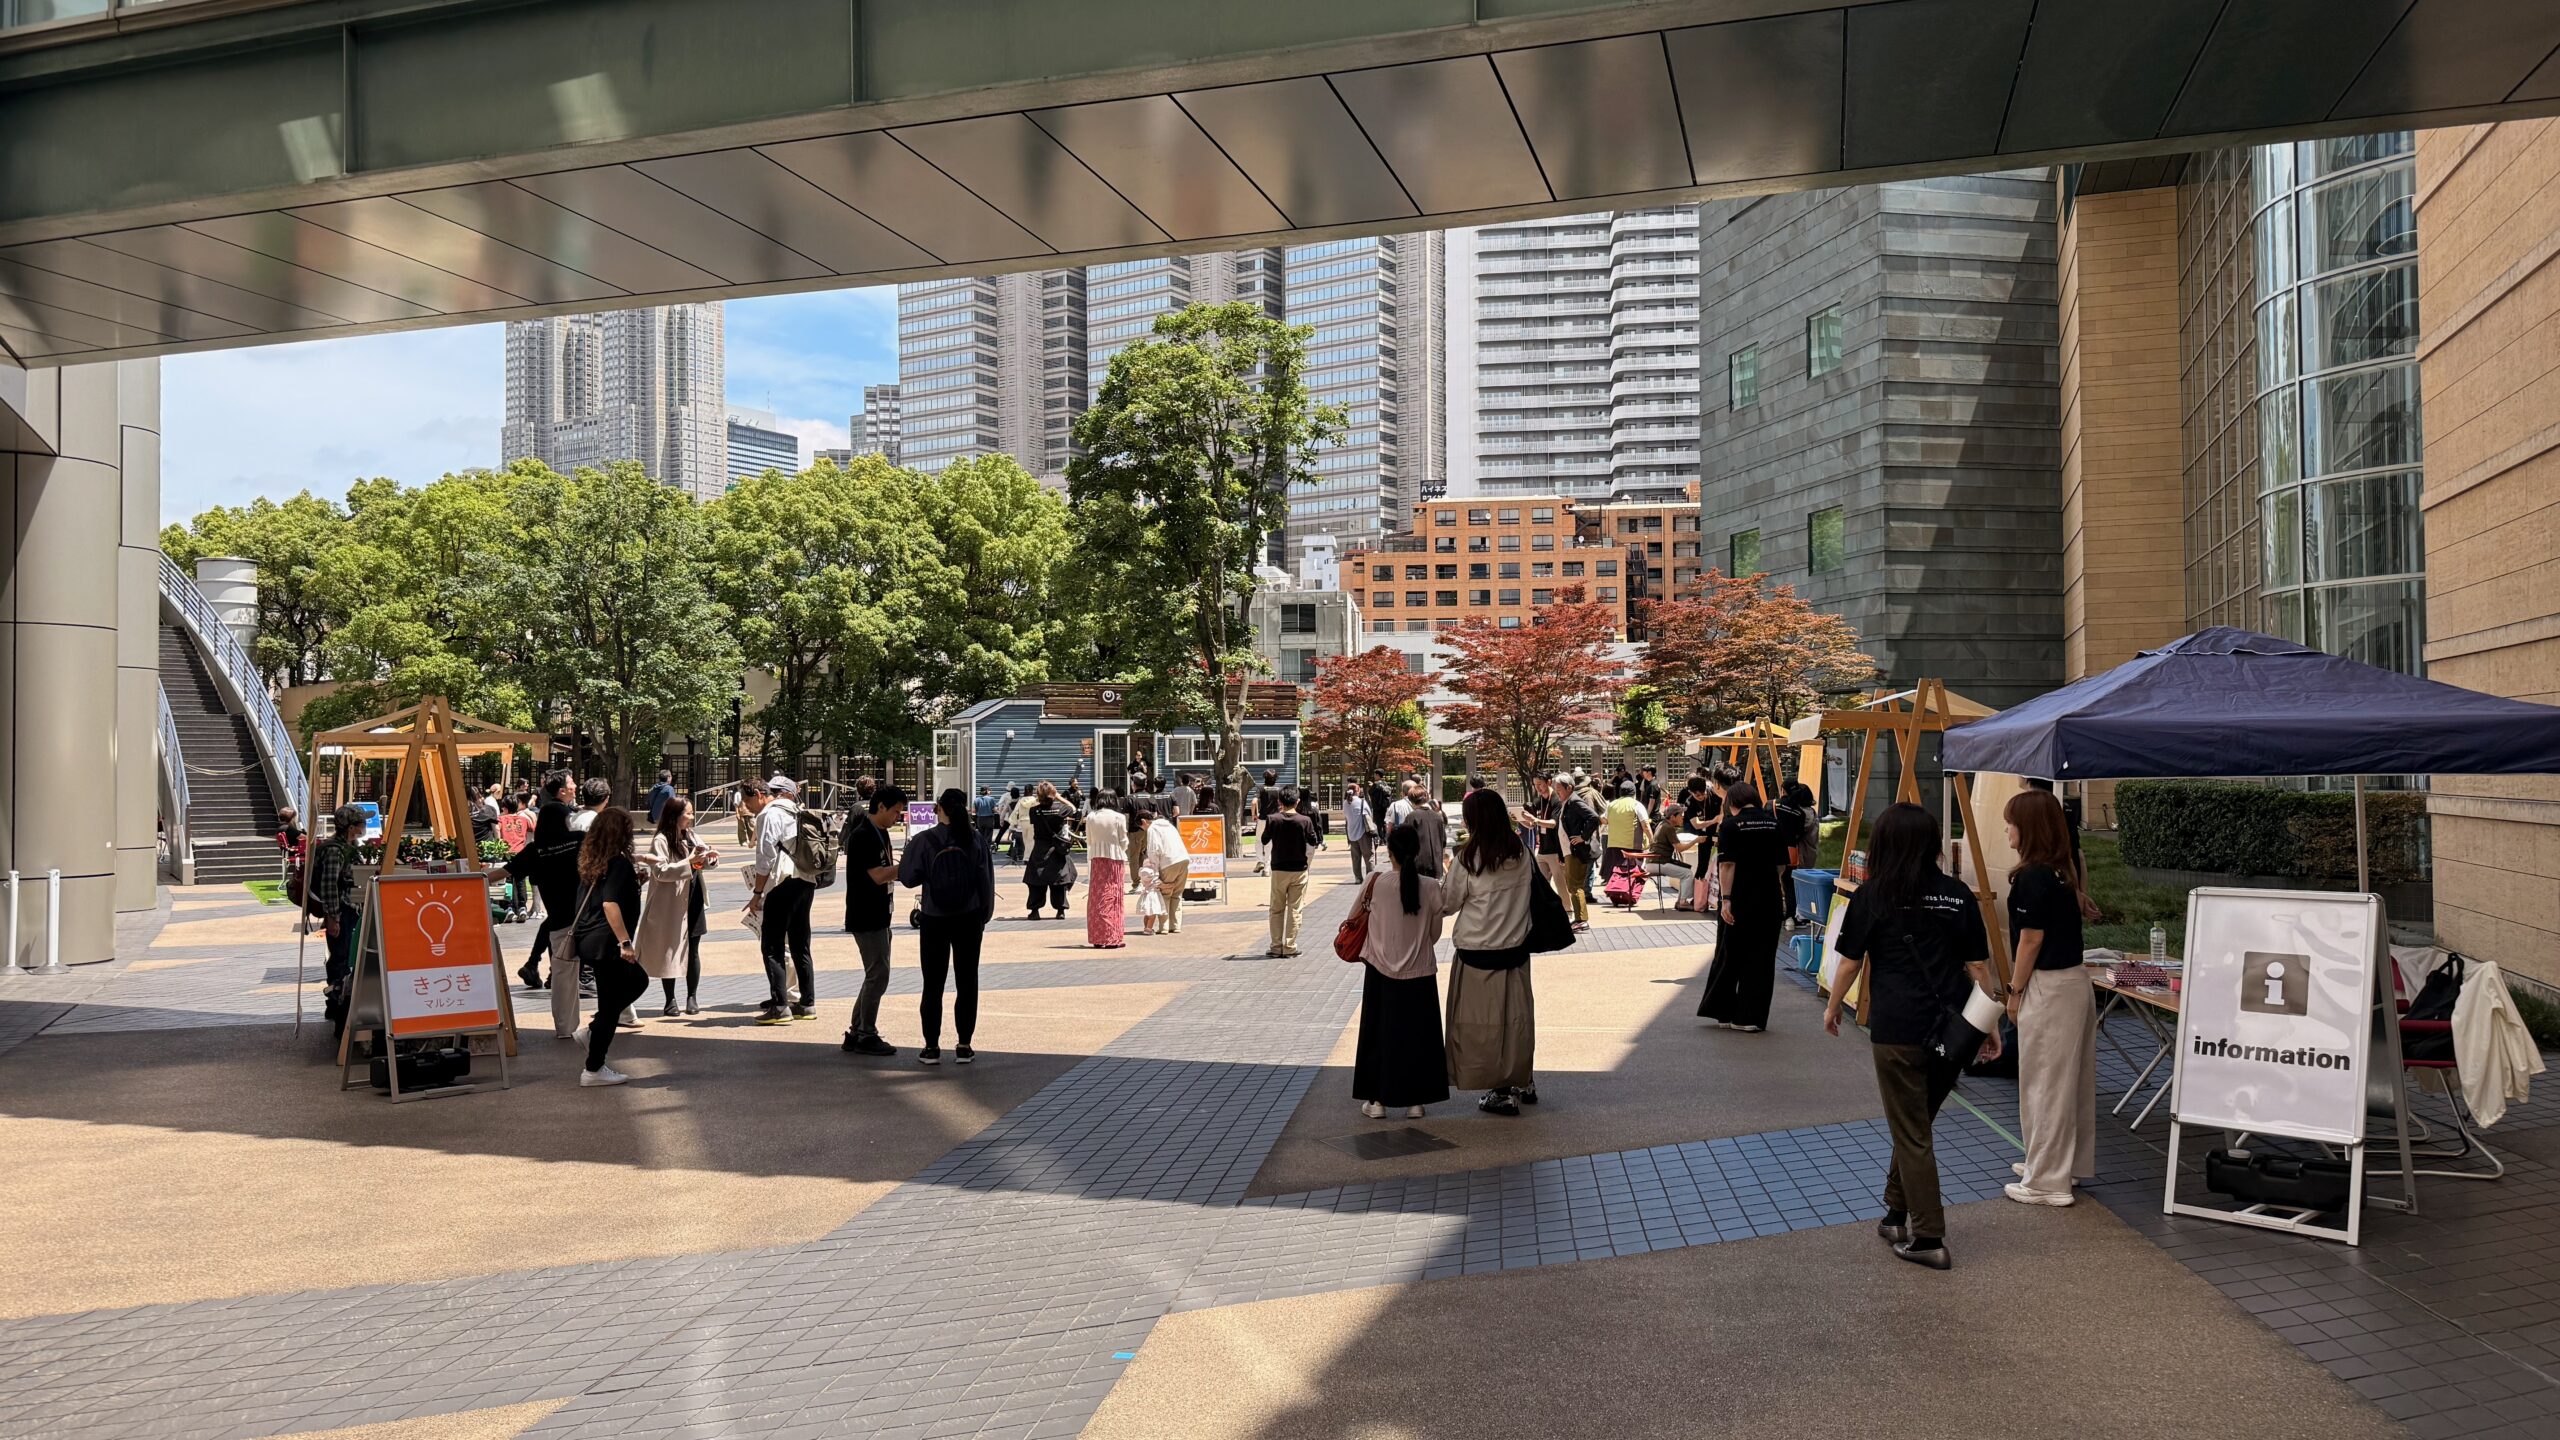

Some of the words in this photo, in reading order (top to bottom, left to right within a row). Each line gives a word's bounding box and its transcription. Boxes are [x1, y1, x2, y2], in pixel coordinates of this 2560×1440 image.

[1421, 485, 1447, 493] ハイネス
[413, 973, 472, 996] きづき
[424, 998, 465, 1009] マルシェ
[2193, 1035, 2350, 1070] information
